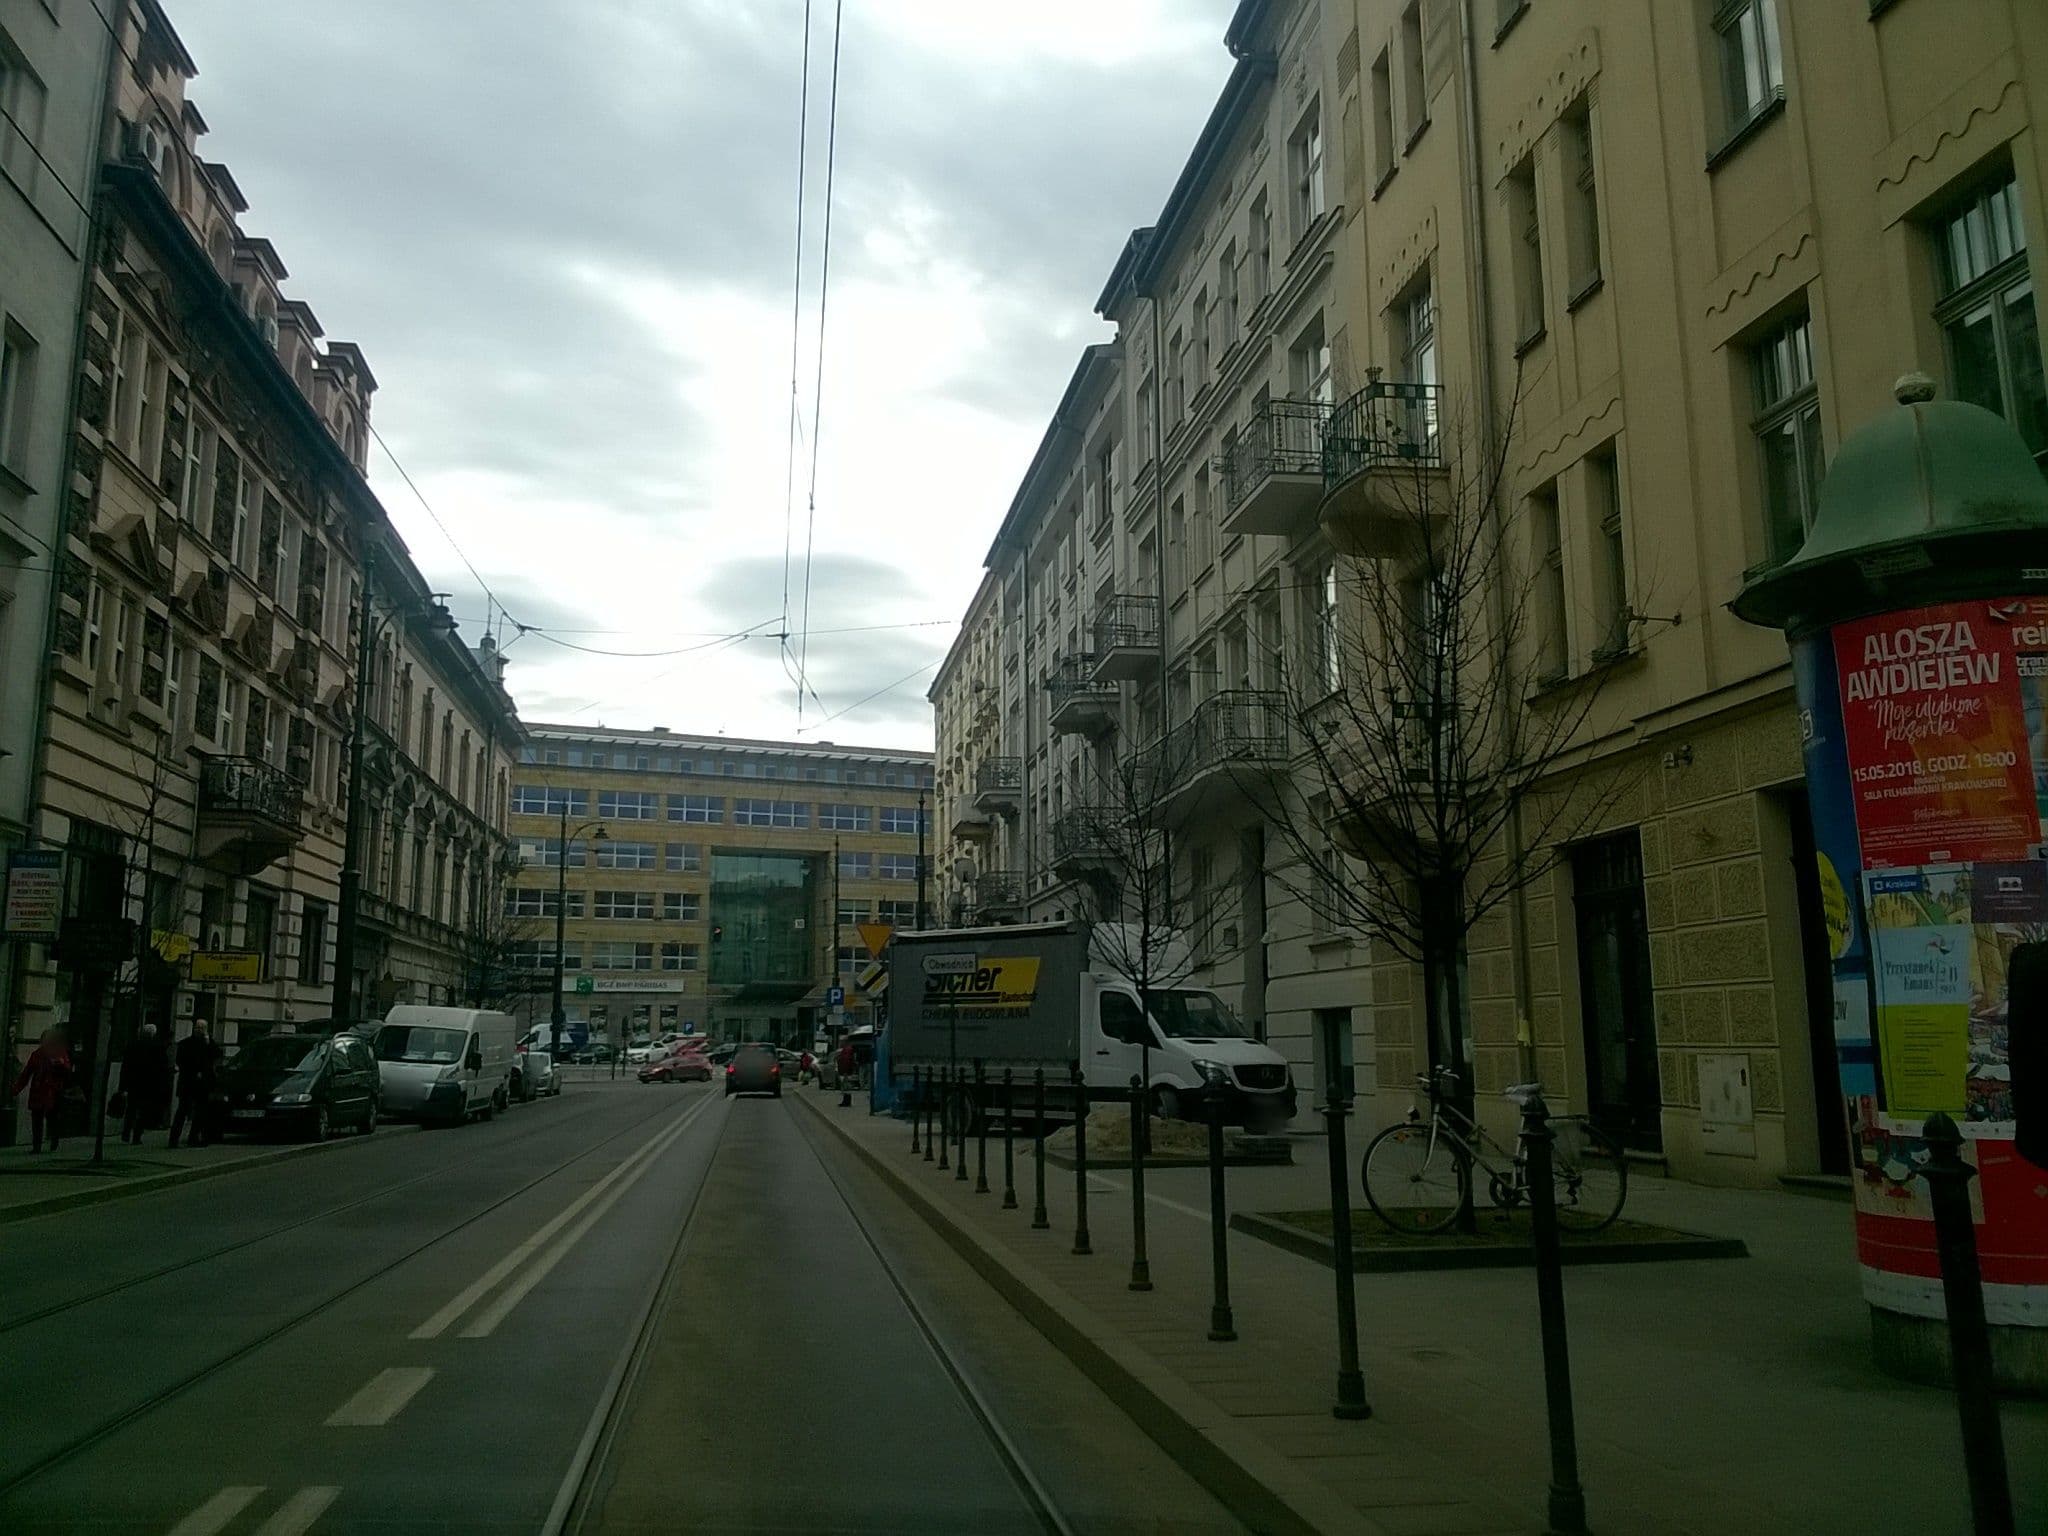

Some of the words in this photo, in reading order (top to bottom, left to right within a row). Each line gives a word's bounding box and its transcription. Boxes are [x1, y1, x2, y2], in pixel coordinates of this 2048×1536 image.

[1864, 621, 1977, 665] ALOSZA
[2012, 620, 2048, 646] rei
[1847, 652, 2000, 702] AWDIEJEW
[1854, 761, 1926, 783] 15.05.2018,
[1927, 754, 1971, 774] GODZ.
[1975, 751, 2017, 768] 19:00
[1864, 789, 1883, 801] SALA
[830, 988, 842, 1004] P
